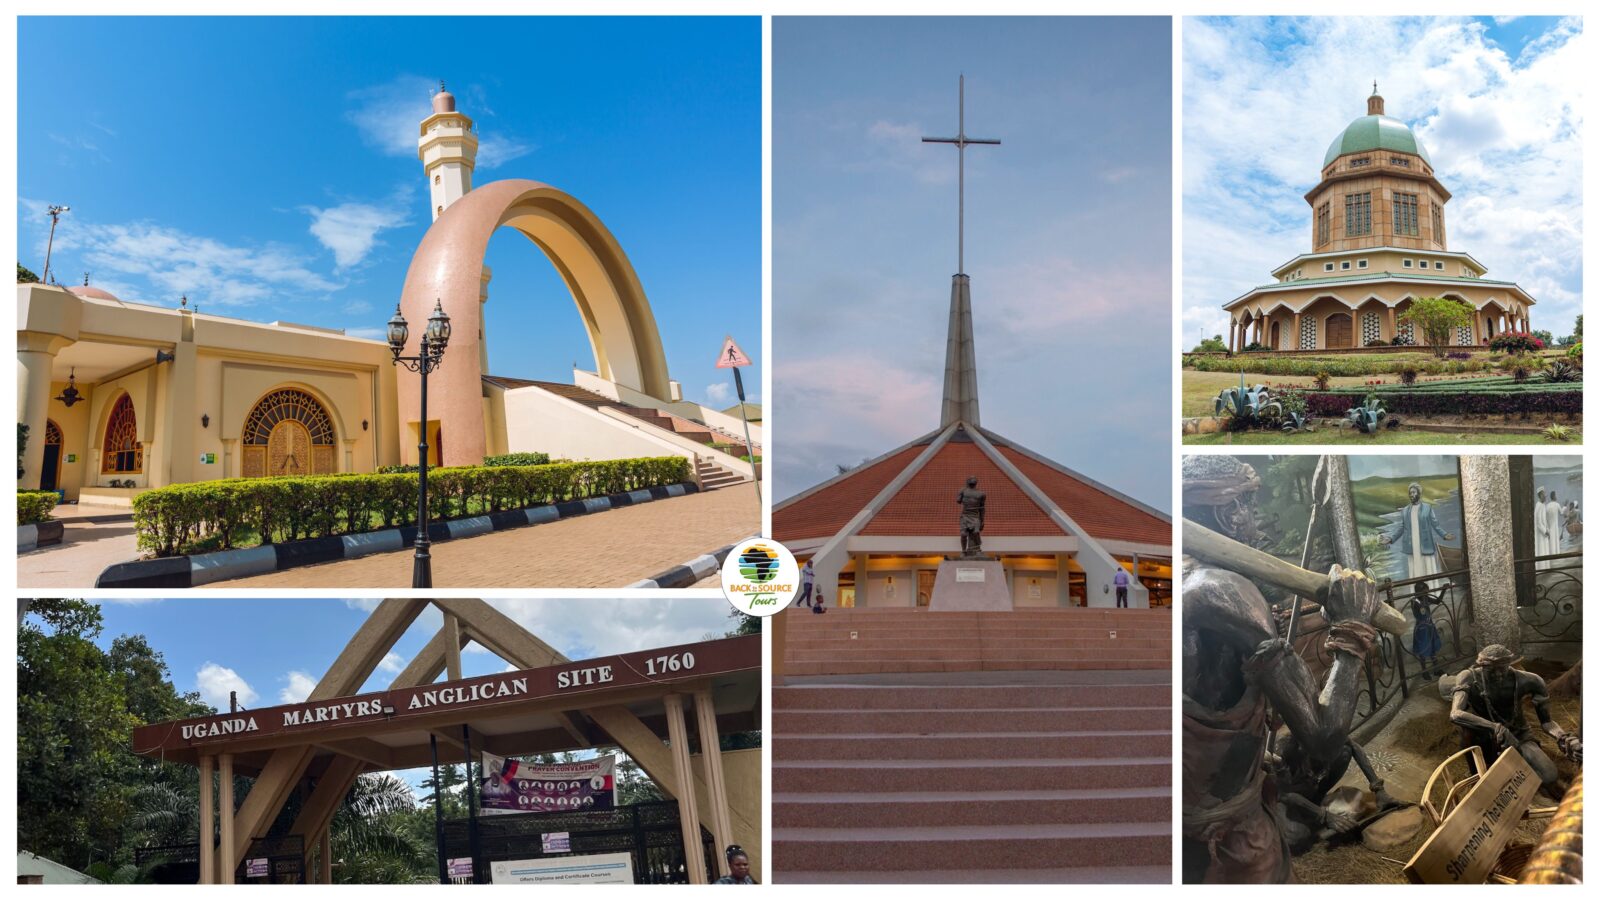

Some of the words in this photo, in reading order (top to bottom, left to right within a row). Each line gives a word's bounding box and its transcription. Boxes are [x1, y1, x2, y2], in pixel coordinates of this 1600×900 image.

[181, 716, 260, 740] UGANDA
[282, 699, 383, 727] MARTYRS
[407, 677, 528, 710] ANGLICAN
[557, 665, 614, 689] SITE
[645, 651, 696, 676] 1760
[556, 763, 600, 773] CONVENTION
[1446, 823, 1493, 881] Sharpening
[1482, 807, 1503, 827] The
[1494, 784, 1518, 811] Killing
[564, 872, 590, 880] Certificate
